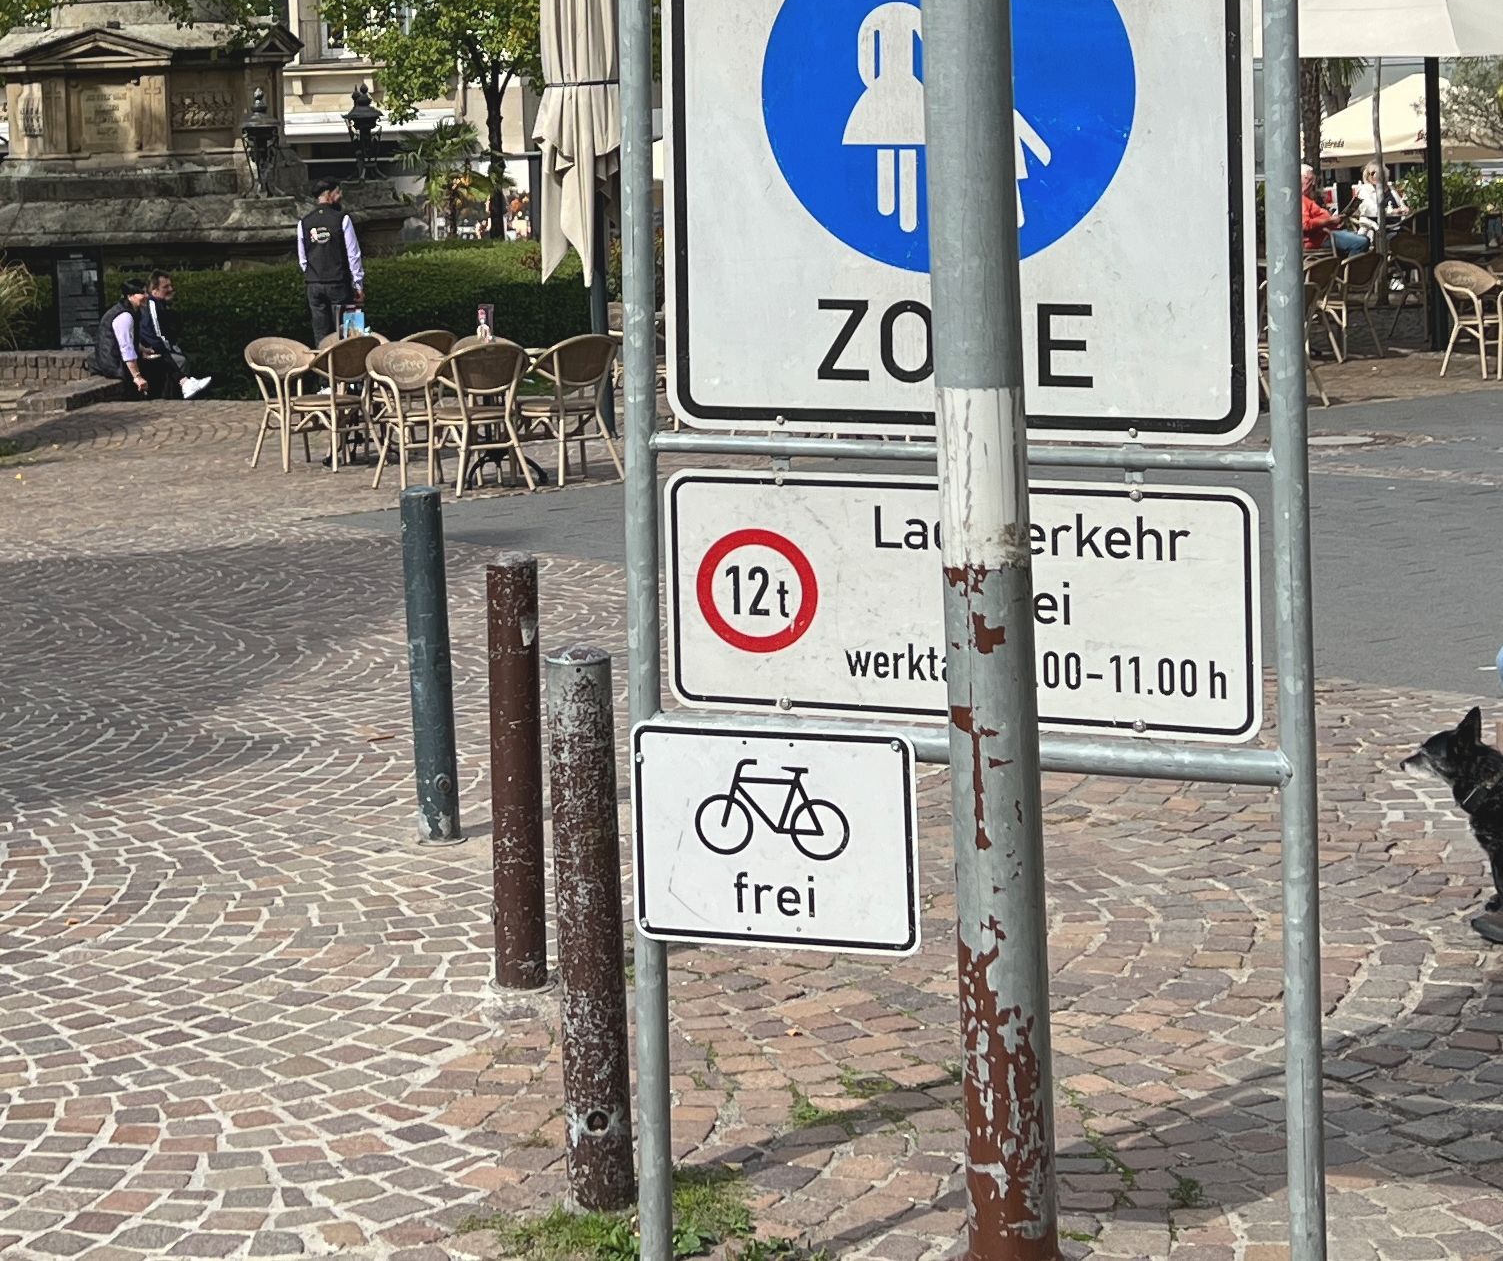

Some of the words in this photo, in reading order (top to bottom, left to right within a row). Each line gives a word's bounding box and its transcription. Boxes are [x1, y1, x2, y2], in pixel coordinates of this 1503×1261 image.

[816, 297, 1095, 389] ZOE
[874, 505, 1191, 561] Laerkehr
[1033, 581, 1072, 625] ei
[845, 642, 948, 682] werkt
[1034, 650, 1198, 698] .00-11.00
[733, 872, 817, 920] frei
